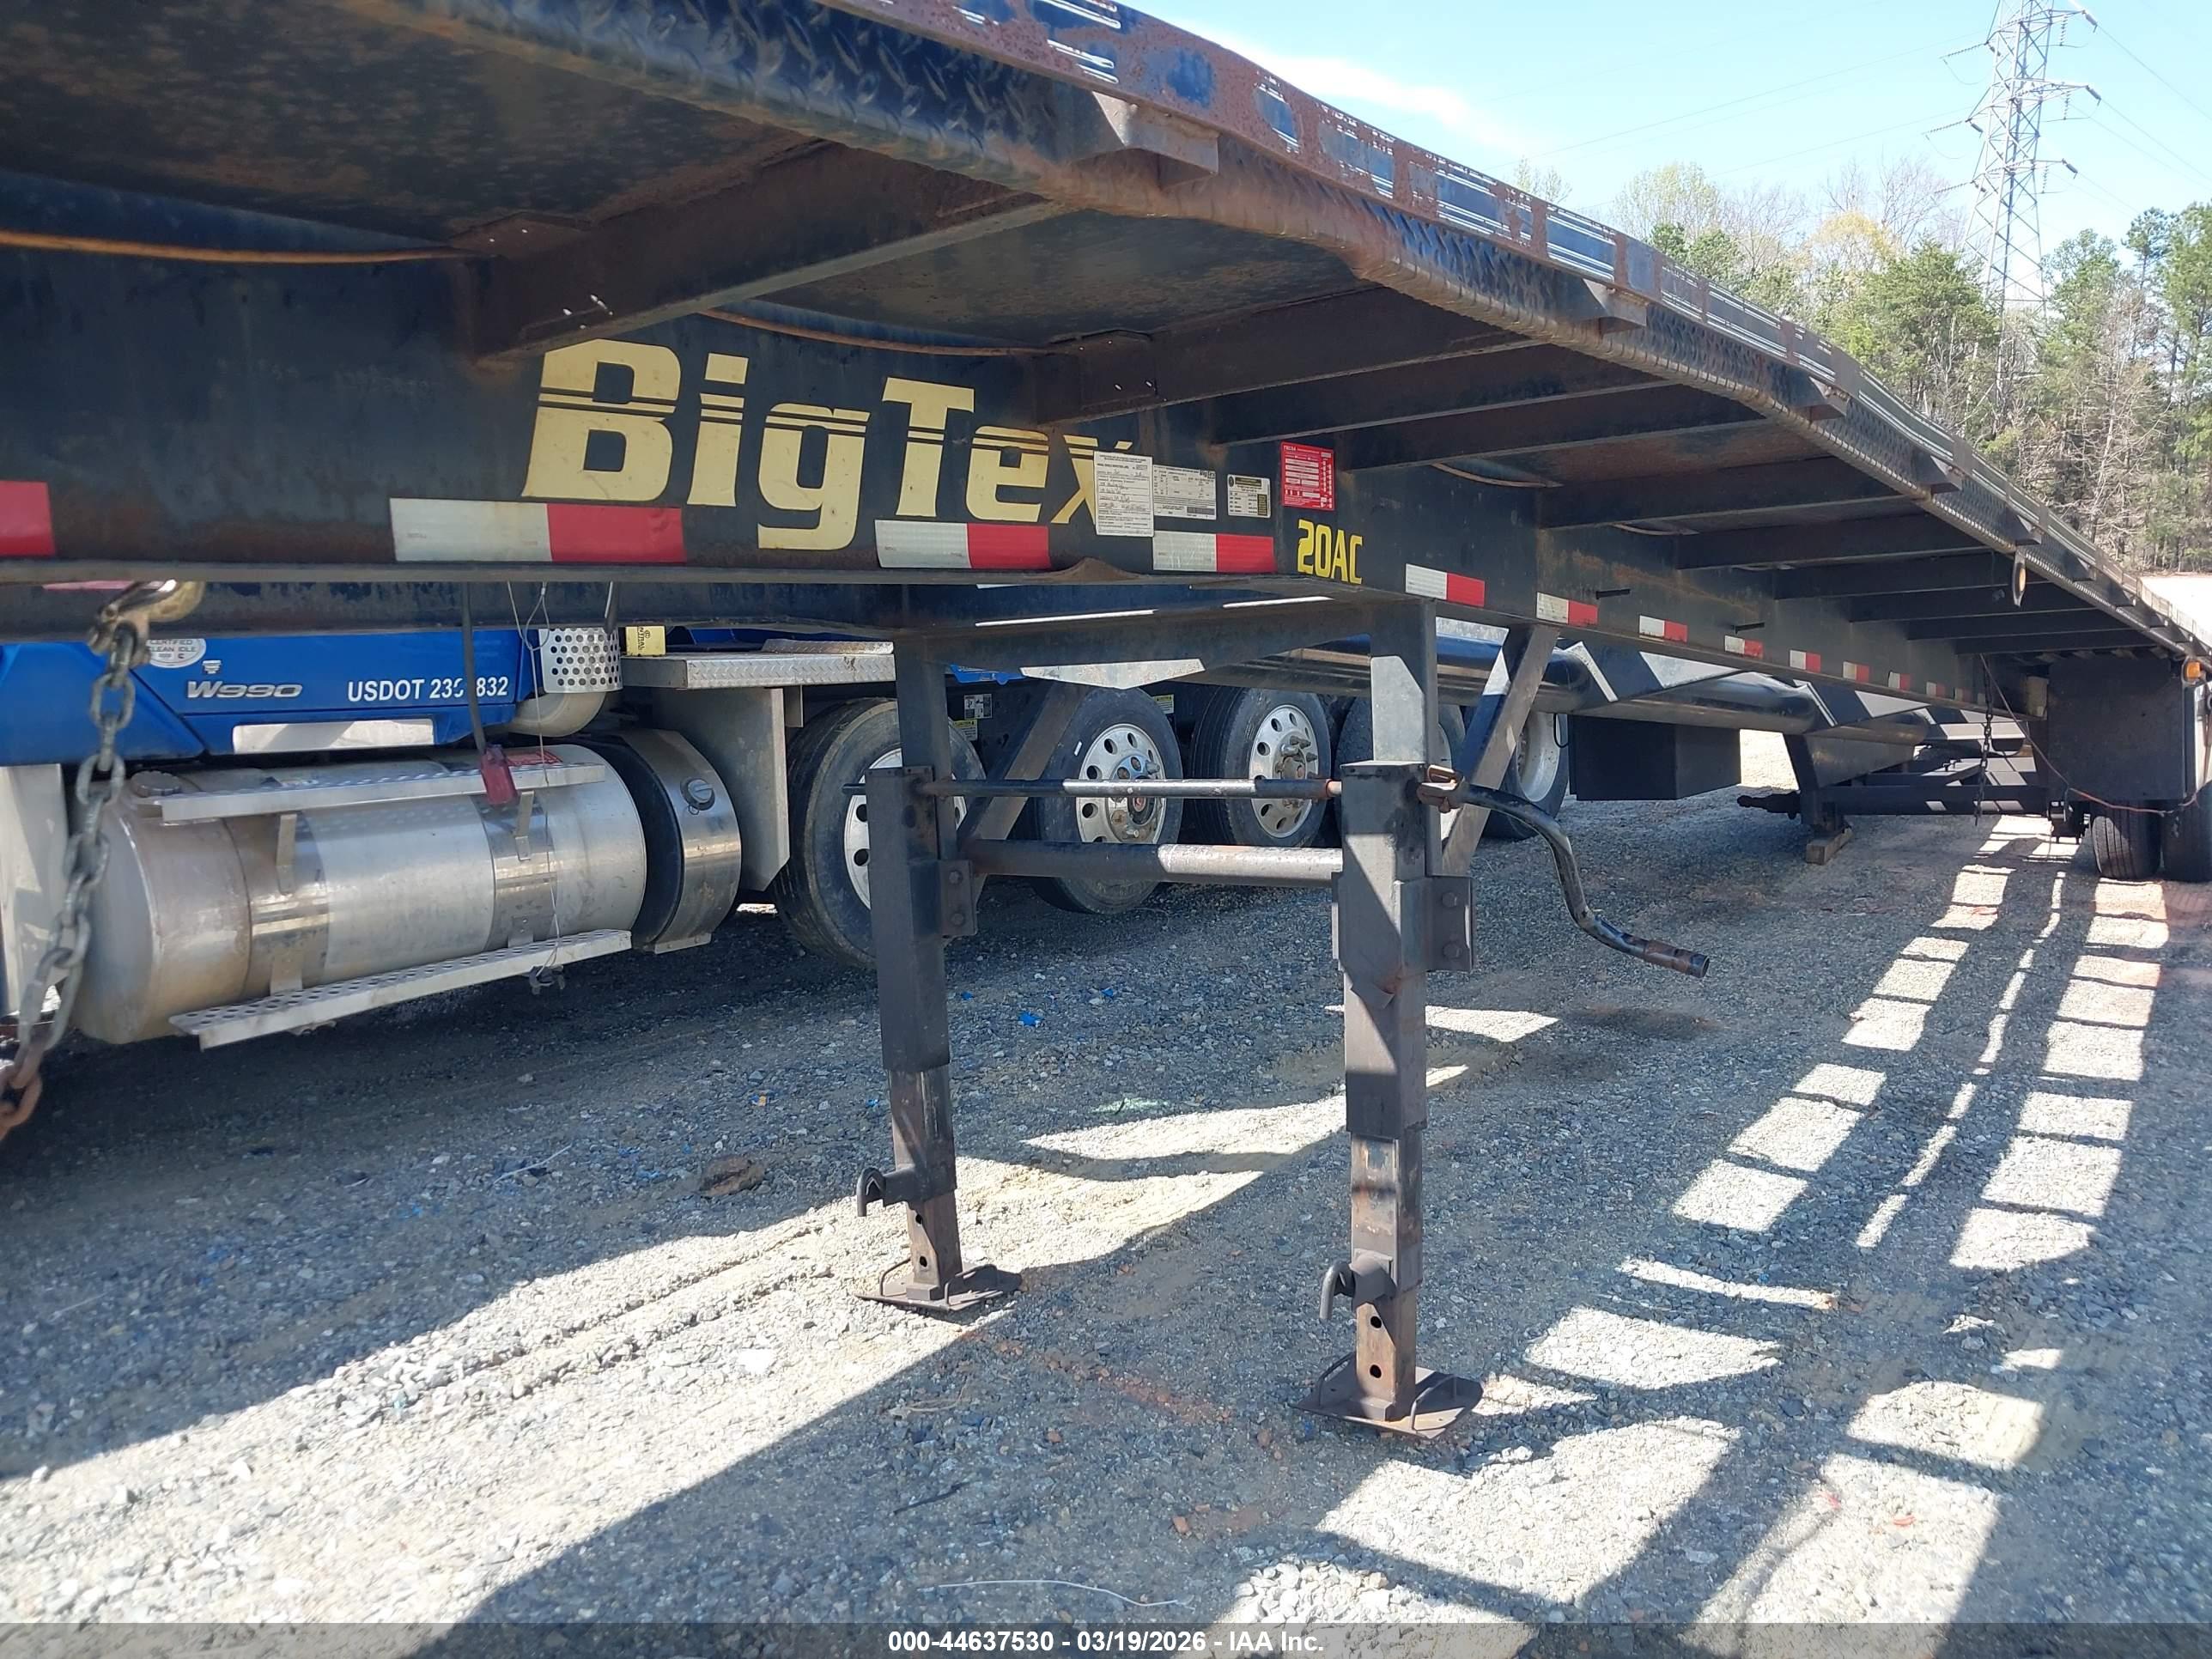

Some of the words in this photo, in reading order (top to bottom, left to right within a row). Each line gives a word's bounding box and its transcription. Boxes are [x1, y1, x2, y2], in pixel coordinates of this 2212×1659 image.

[1297, 519, 1363, 585] 20AC
[187, 680, 303, 698] W990
[348, 678, 425, 702] USDOT
